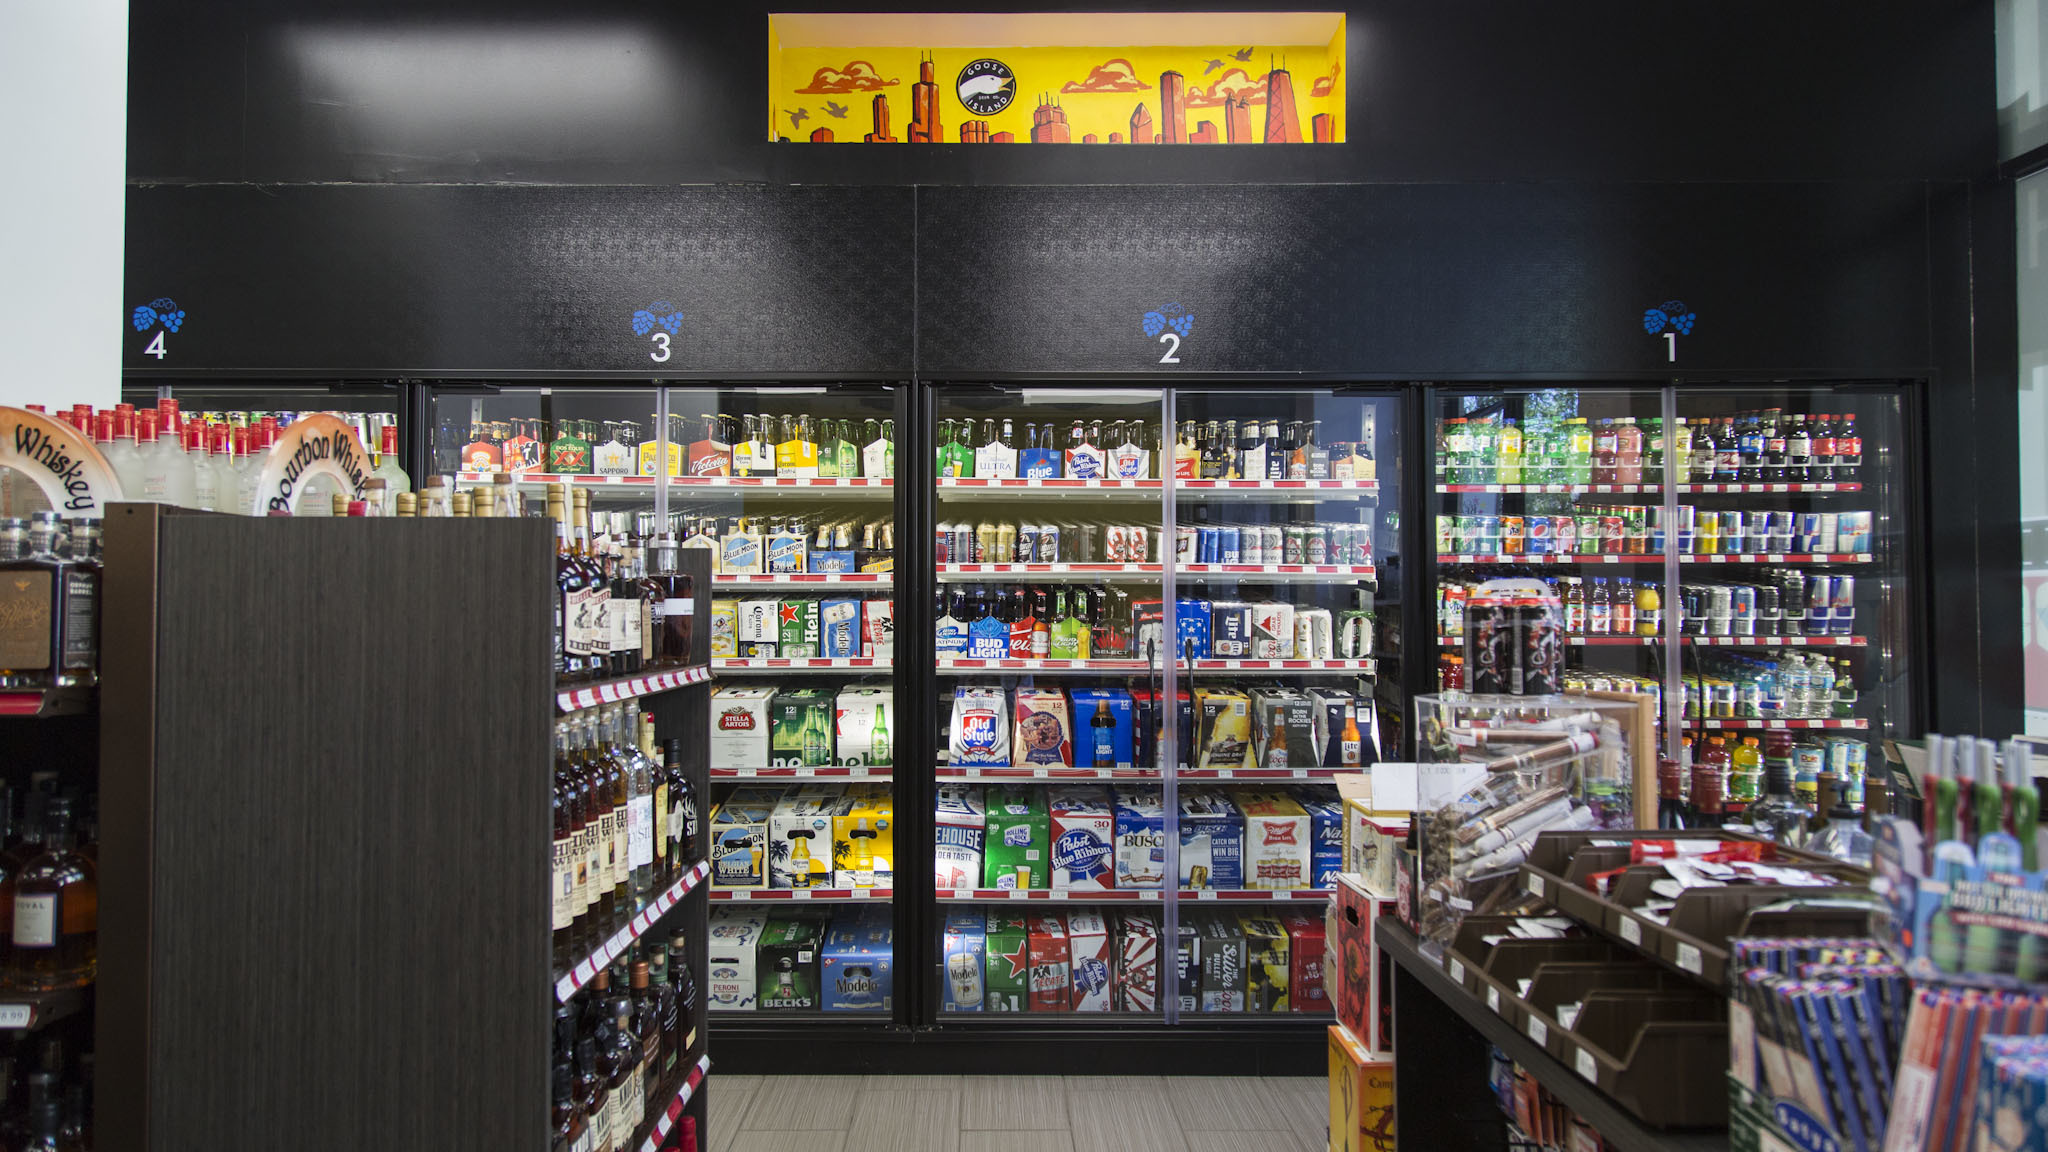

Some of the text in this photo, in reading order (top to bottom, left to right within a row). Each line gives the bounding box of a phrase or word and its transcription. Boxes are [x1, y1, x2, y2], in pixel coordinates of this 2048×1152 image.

[967, 62, 1005, 76] GOOSE
[967, 97, 1007, 113] ISLAND
[144, 331, 167, 359] 4
[650, 332, 671, 362] 3
[1159, 333, 1180, 363] 2
[1663, 333, 1675, 362] 1
[552, 450, 588, 467] XX
[690, 453, 729, 474] Victoria
[1122, 459, 1134, 467] Old
[15, 422, 95, 513] Whiskey
[269, 429, 370, 511] Bourbon Whisk
[599, 467, 629, 475] SAPPORO
[979, 462, 1012, 471] ULTRA
[1027, 466, 1053, 478] Blue
[722, 542, 759, 560] BLUE MOON
[767, 542, 804, 560] BLUE MOON
[816, 560, 846, 571] Modelo
[753, 606, 763, 638] Corona
[804, 600, 819, 643] Hein
[1225, 616, 1239, 639] Lite
[782, 628, 791, 642] 12
[838, 621, 850, 655] Modelo
[975, 638, 1004, 648] BUD
[969, 648, 1008, 658] LIGHT
[969, 717, 990, 730] Old
[963, 727, 995, 746] Style
[1343, 742, 1358, 751] Lite
[1094, 820, 1110, 828] 30
[936, 827, 982, 850] EHOUSE
[1005, 828, 1028, 836] ROLLING
[1060, 835, 1090, 853] Pabst
[1123, 835, 1164, 847] BUSC
[936, 850, 973, 861] DER TASTE
[1052, 854, 1075, 869] Blue
[1074, 845, 1112, 860] Ribbon
[1213, 847, 1227, 857] WIN
[1221, 943, 1238, 989] Silver
[950, 967, 978, 981] Modelo
[1035, 974, 1067, 988] TECATE
[713, 983, 740, 992] PERONI
[835, 978, 878, 993] Modelo
[763, 996, 812, 1008] BECK'S
